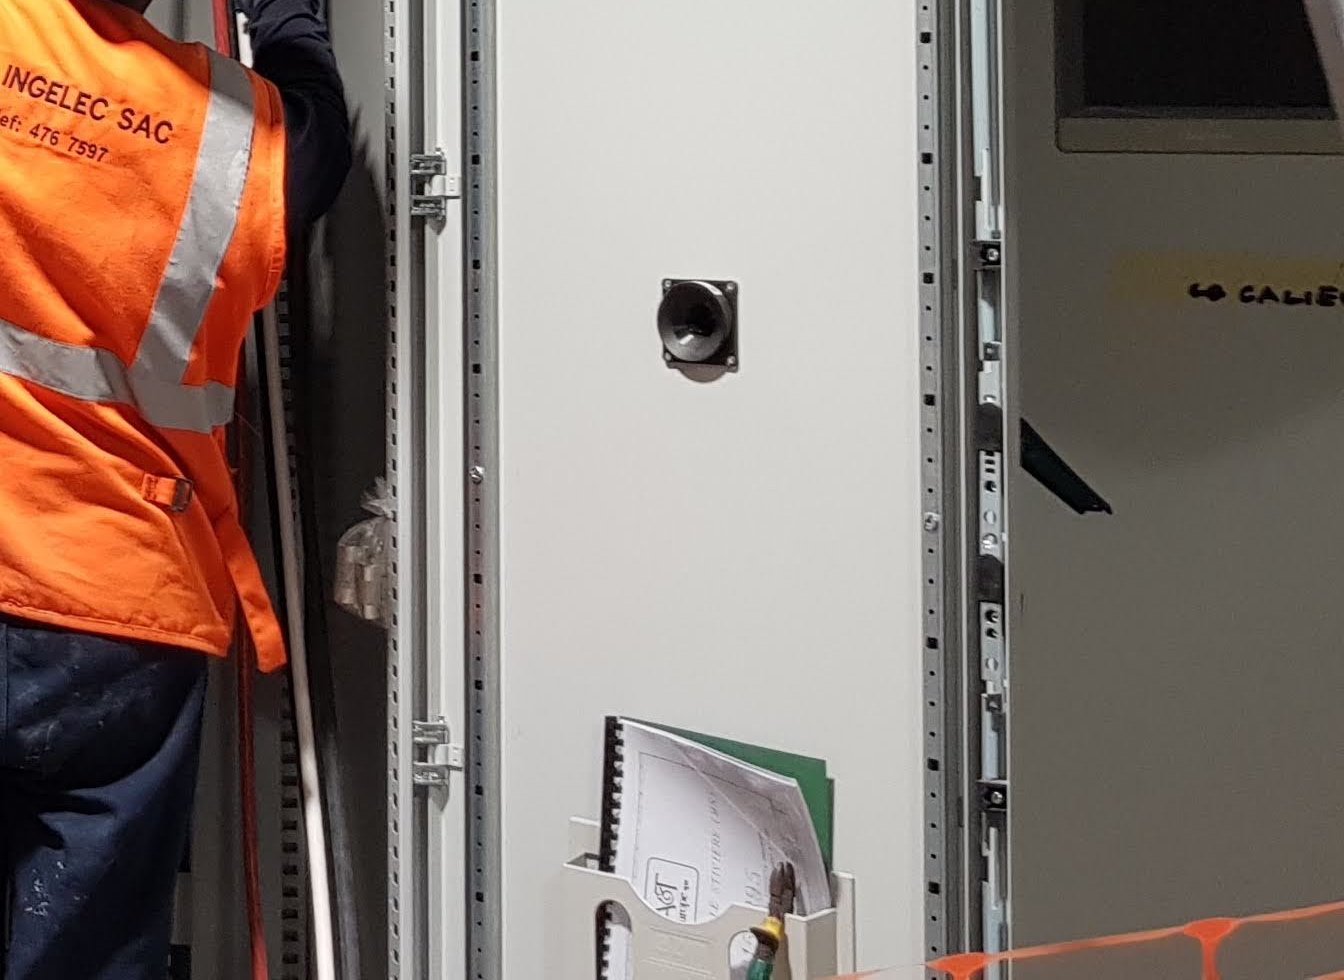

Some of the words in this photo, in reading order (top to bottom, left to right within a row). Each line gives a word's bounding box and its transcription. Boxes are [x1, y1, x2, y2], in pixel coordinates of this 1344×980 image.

[1, 64, 110, 121] INGELEC
[116, 107, 174, 144] SAC
[28, 122, 61, 146] 476
[66, 135, 109, 163] 7597
[1239, 285, 1344, 307] CALIE
